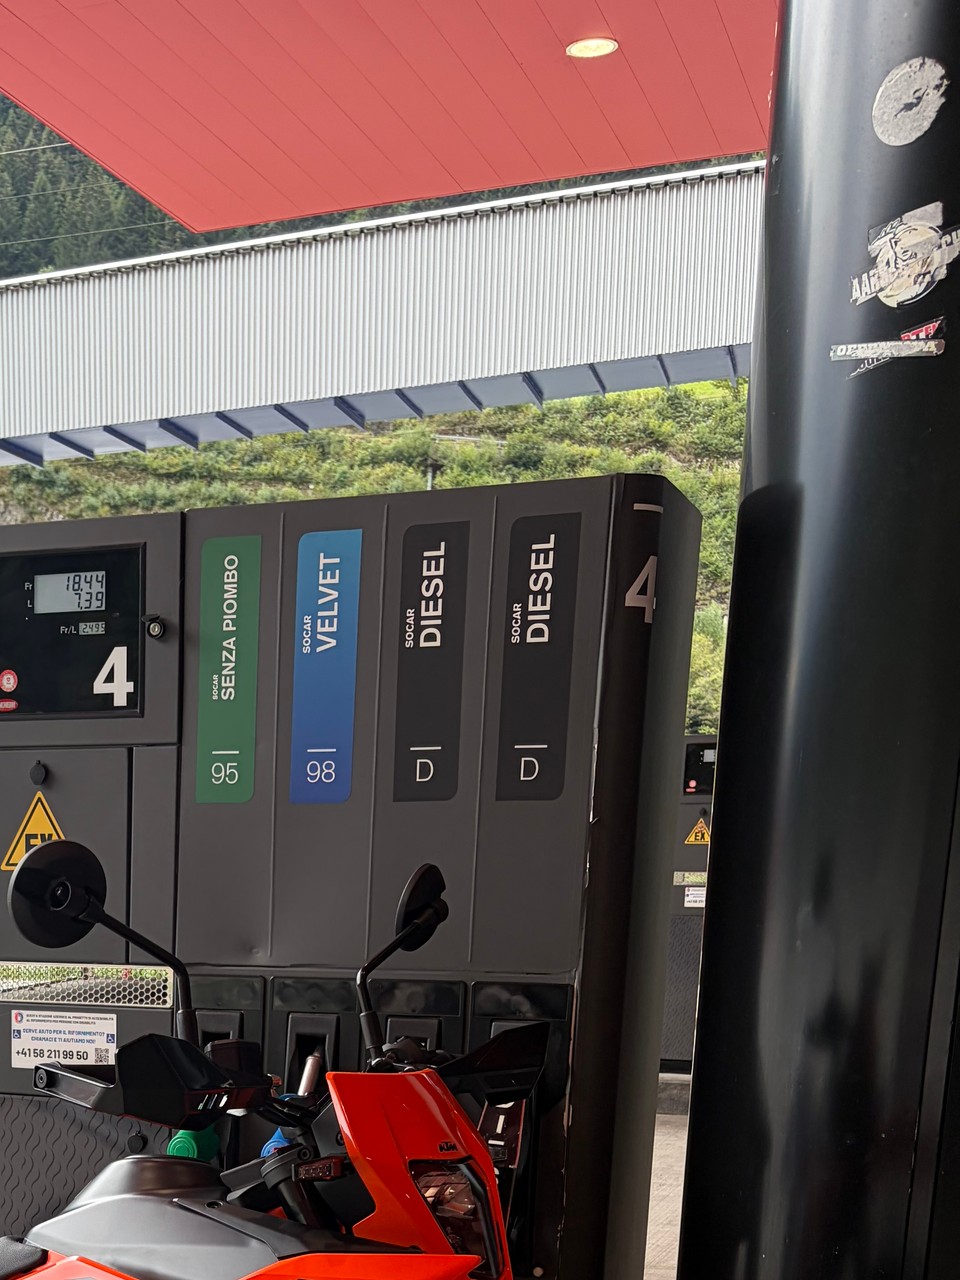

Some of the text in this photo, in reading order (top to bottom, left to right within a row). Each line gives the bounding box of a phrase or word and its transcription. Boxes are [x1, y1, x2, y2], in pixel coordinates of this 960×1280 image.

[24, 582, 33, 591] Fr
[420, 541, 446, 648] DIESEL
[526, 534, 555, 643] DIESEL
[624, 555, 658, 624] 4
[27, 600, 33, 608] L
[316, 552, 341, 653] VELVET
[60, 626, 77, 634] Fr/L
[221, 554, 239, 701] SENZA PIOMBO
[302, 615, 312, 654] SOCAR
[405, 608, 415, 648] SOCAR
[511, 603, 522, 644] SOCAR
[93, 645, 135, 707] 4
[211, 762, 239, 785] 95
[306, 760, 336, 783] 98
[415, 758, 434, 782] D
[520, 757, 539, 781] D
[16, 1048, 89, 1060] +41 58 211 99 50
[438, 1142, 458, 1152] KTM
